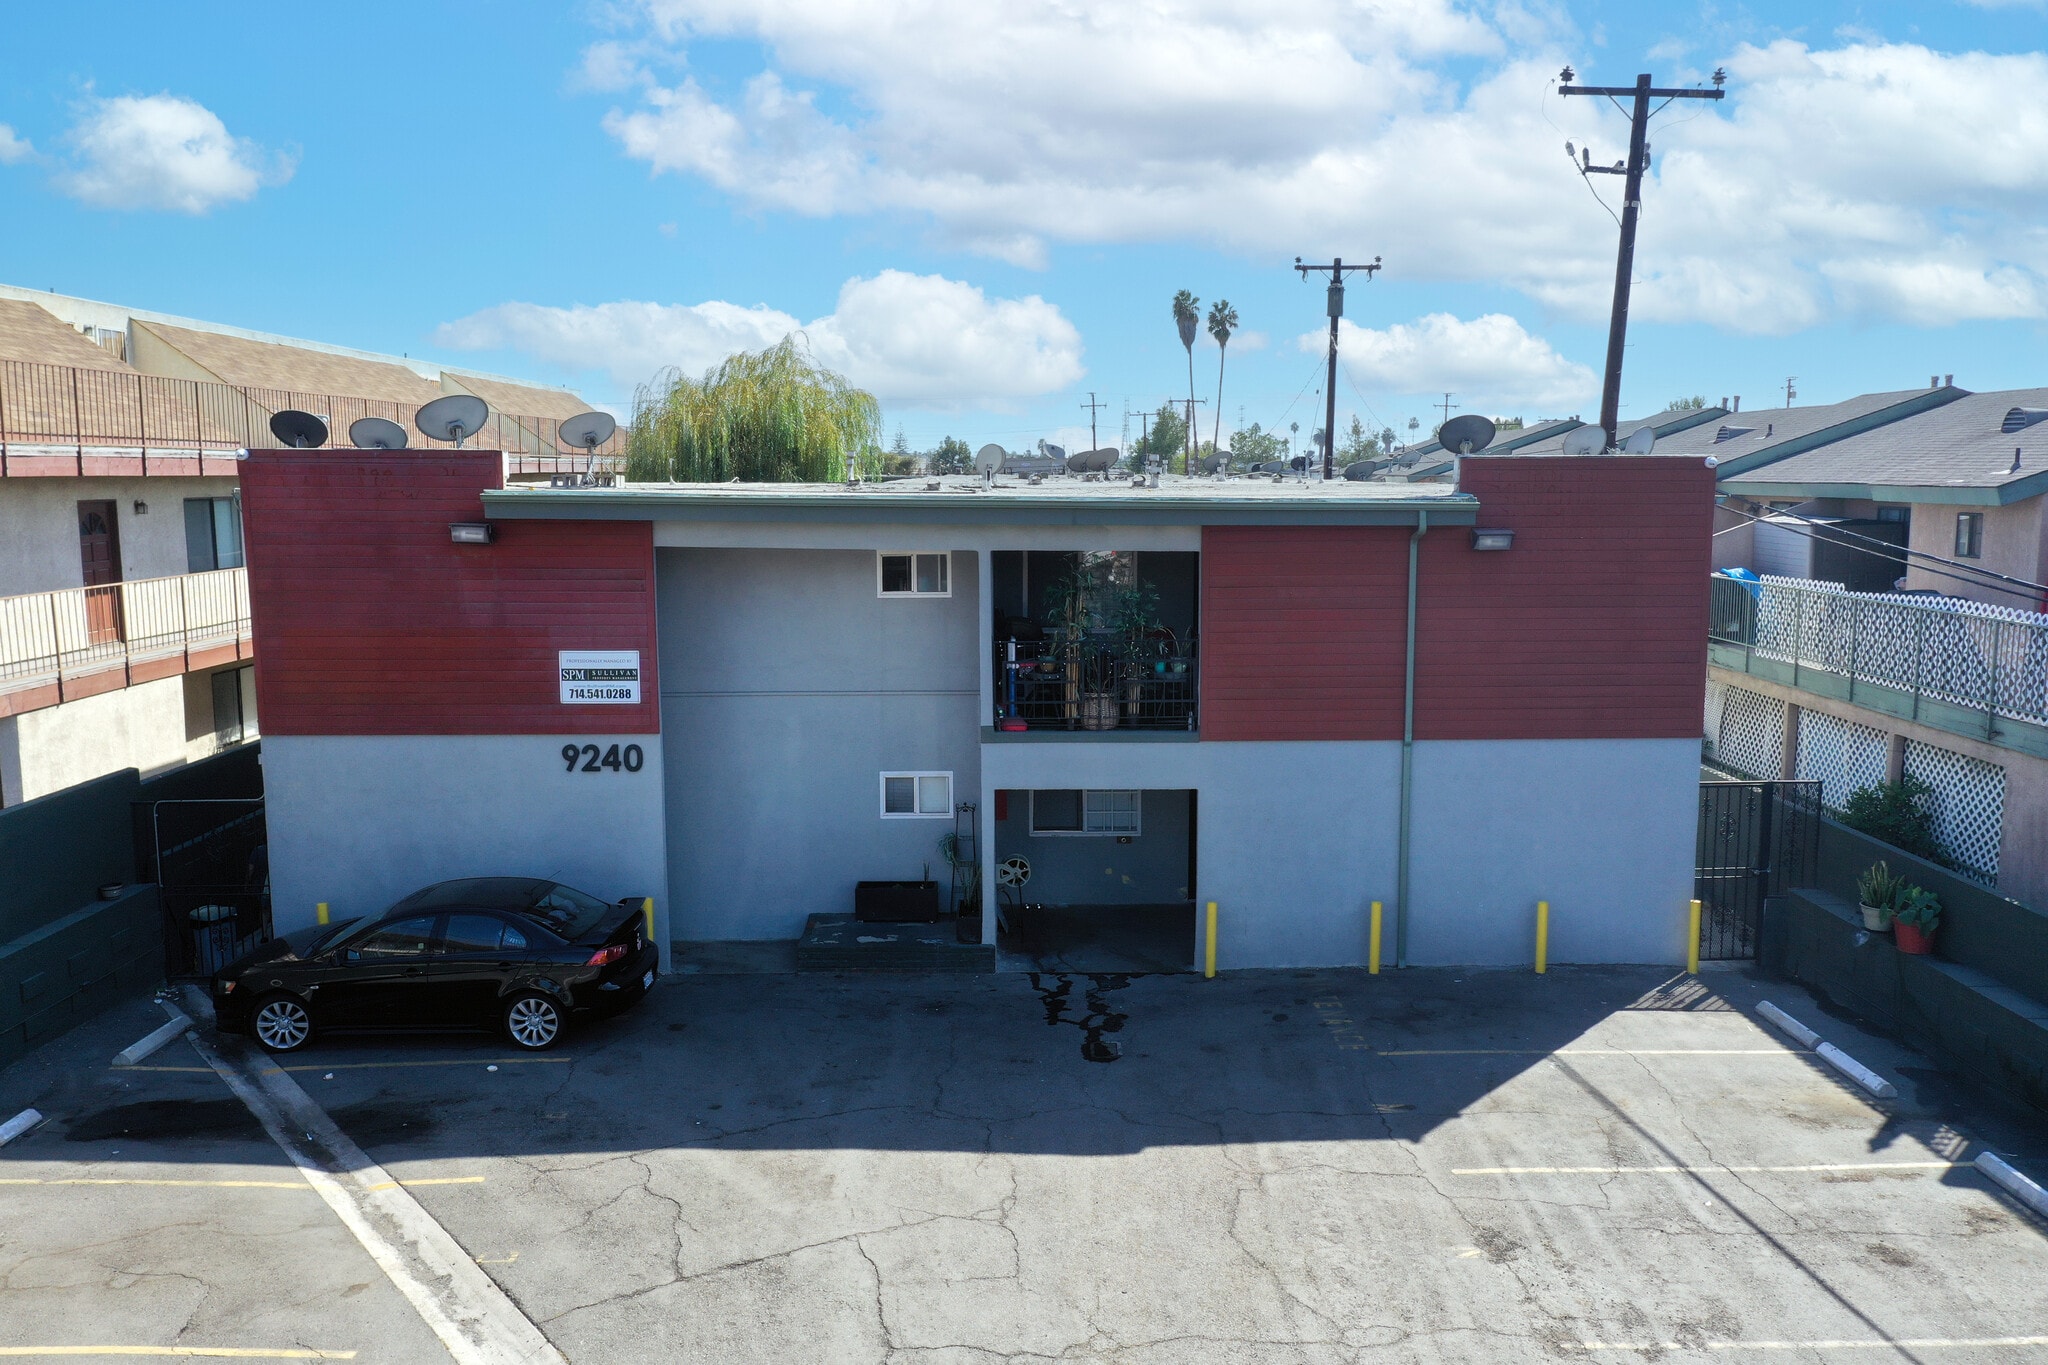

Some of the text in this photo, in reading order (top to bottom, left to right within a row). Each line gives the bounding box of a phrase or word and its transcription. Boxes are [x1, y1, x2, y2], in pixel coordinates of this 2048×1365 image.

[562, 669, 585, 680] SPM
[568, 688, 632, 699] 714.541.0288
[561, 743, 644, 773] 9240
